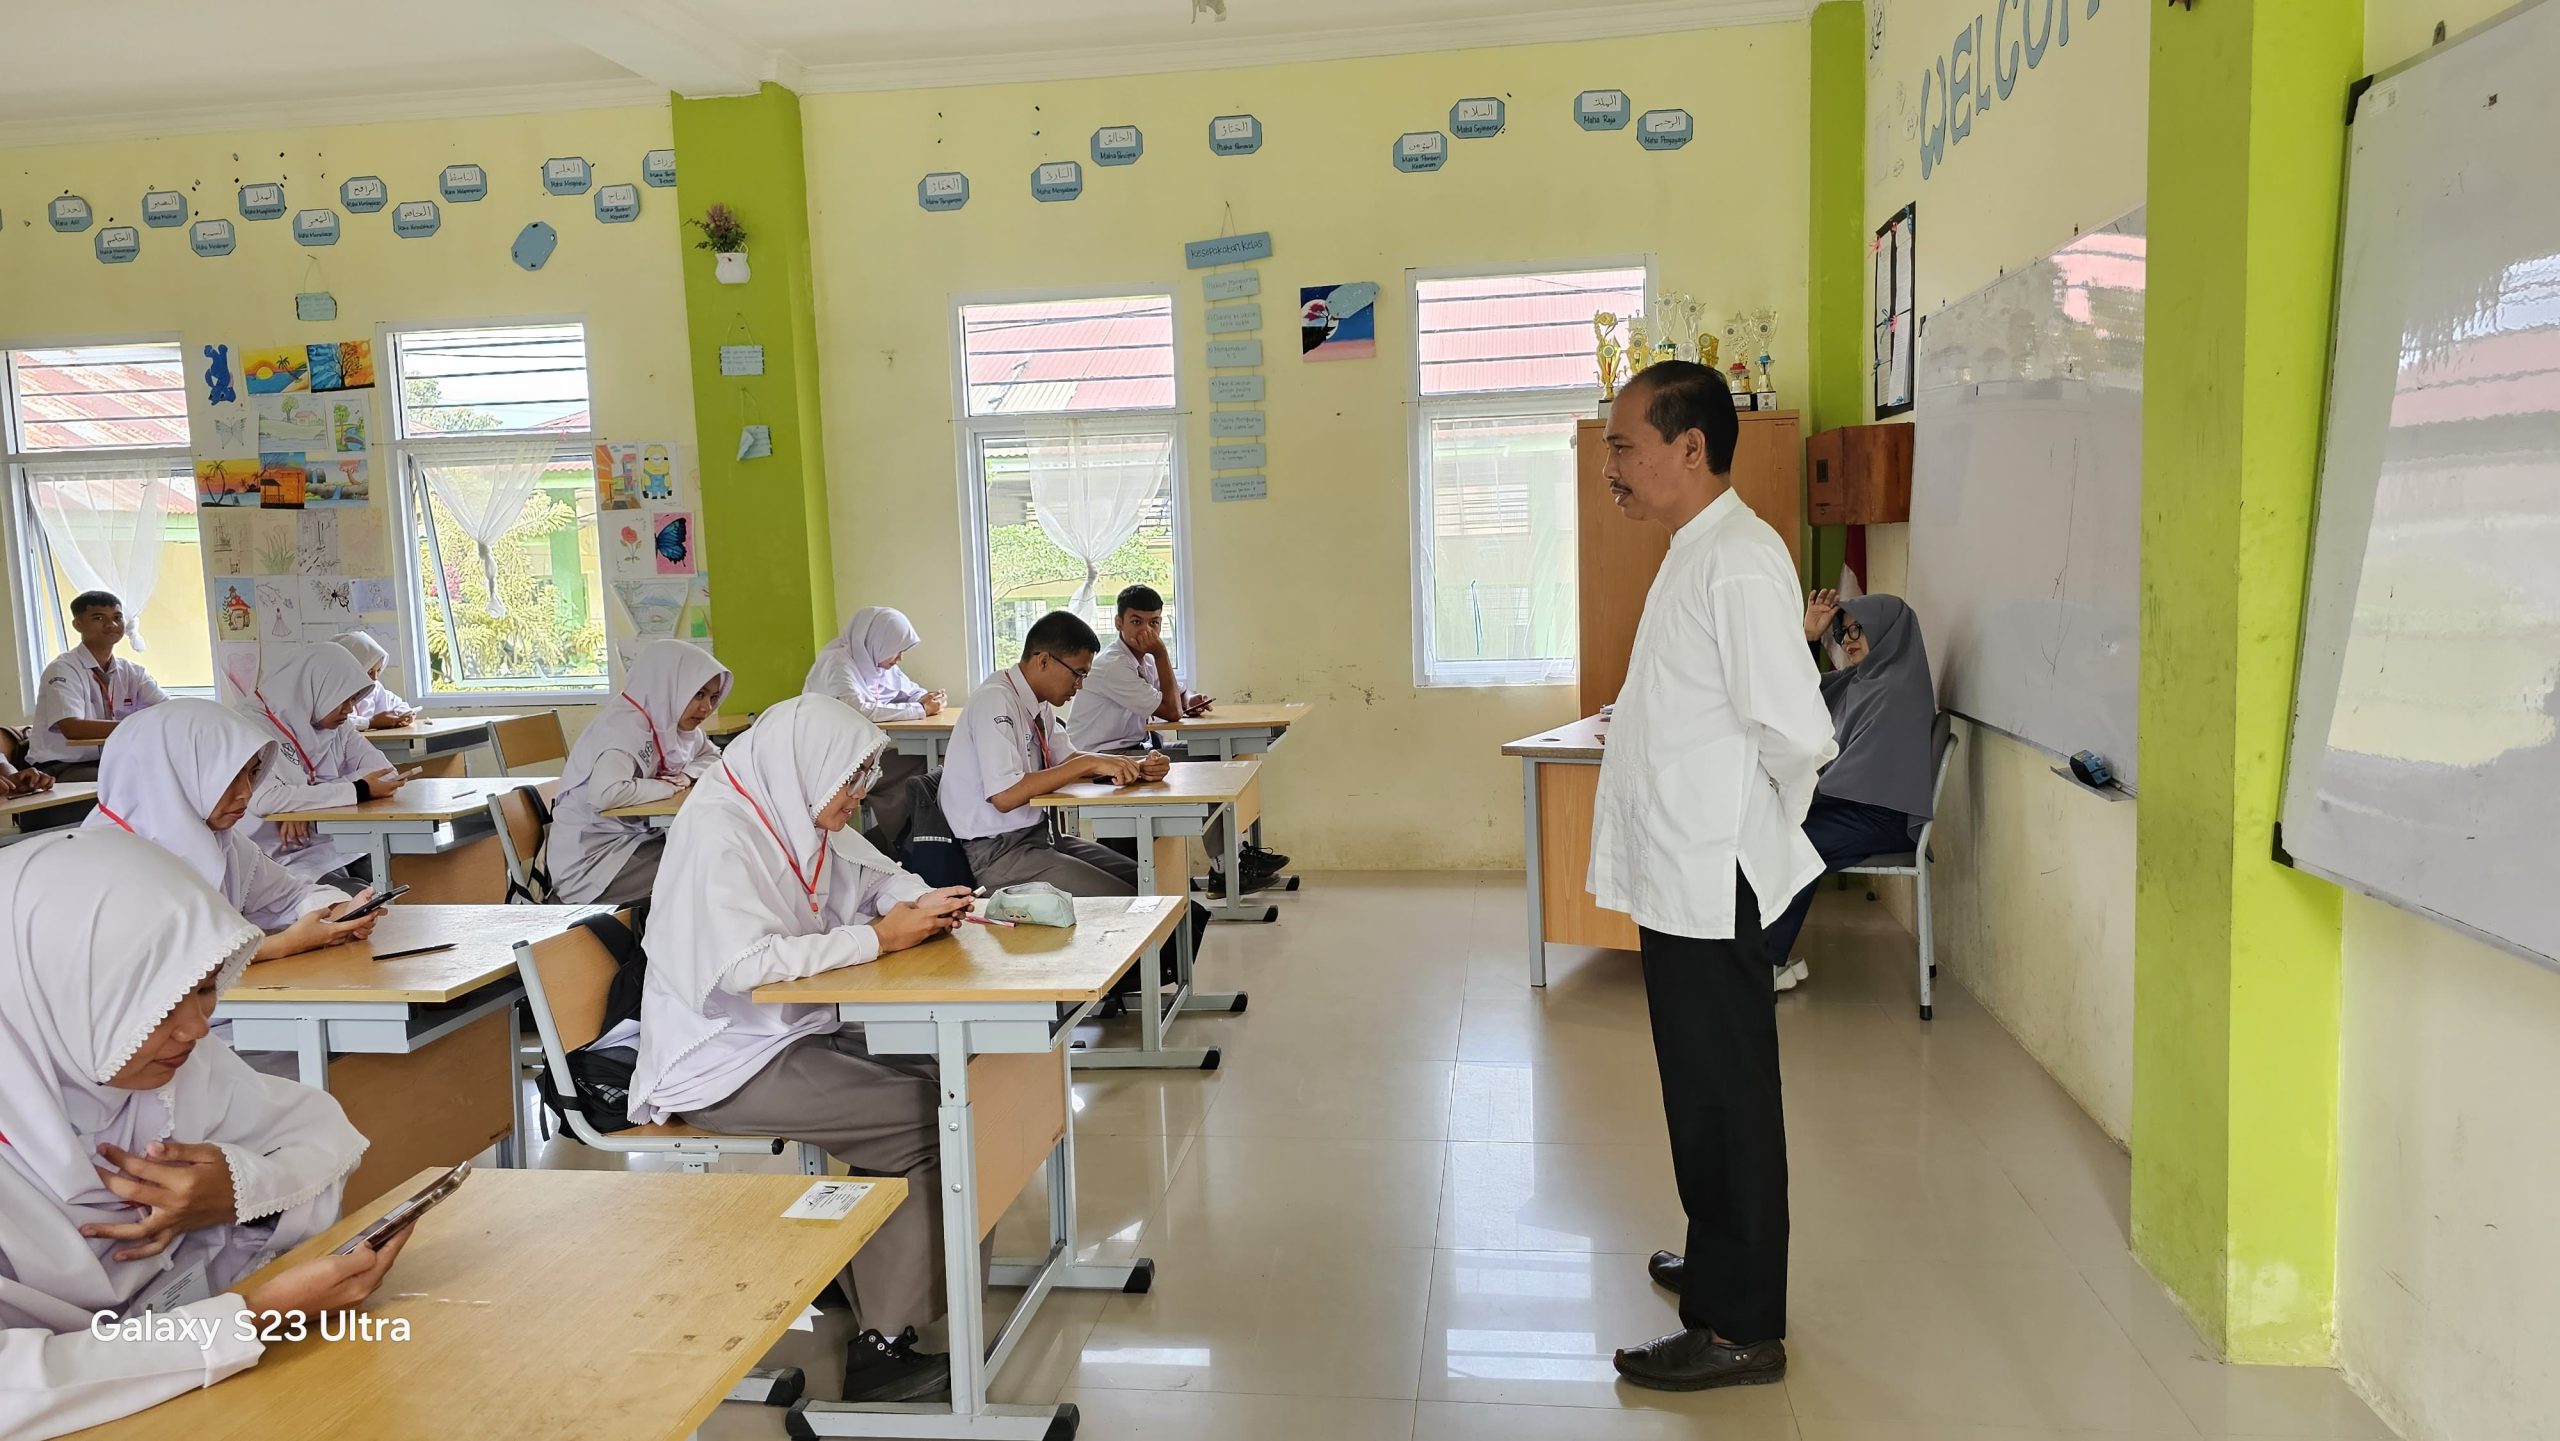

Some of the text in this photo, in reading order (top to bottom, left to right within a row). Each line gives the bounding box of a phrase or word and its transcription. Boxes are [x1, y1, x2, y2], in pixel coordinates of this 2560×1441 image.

[1583, 114, 1616, 125] Maha Raja
[1456, 124, 1472, 133] Maha
[1644, 136, 1658, 144] Maha
[1100, 151, 1116, 159] Maha
